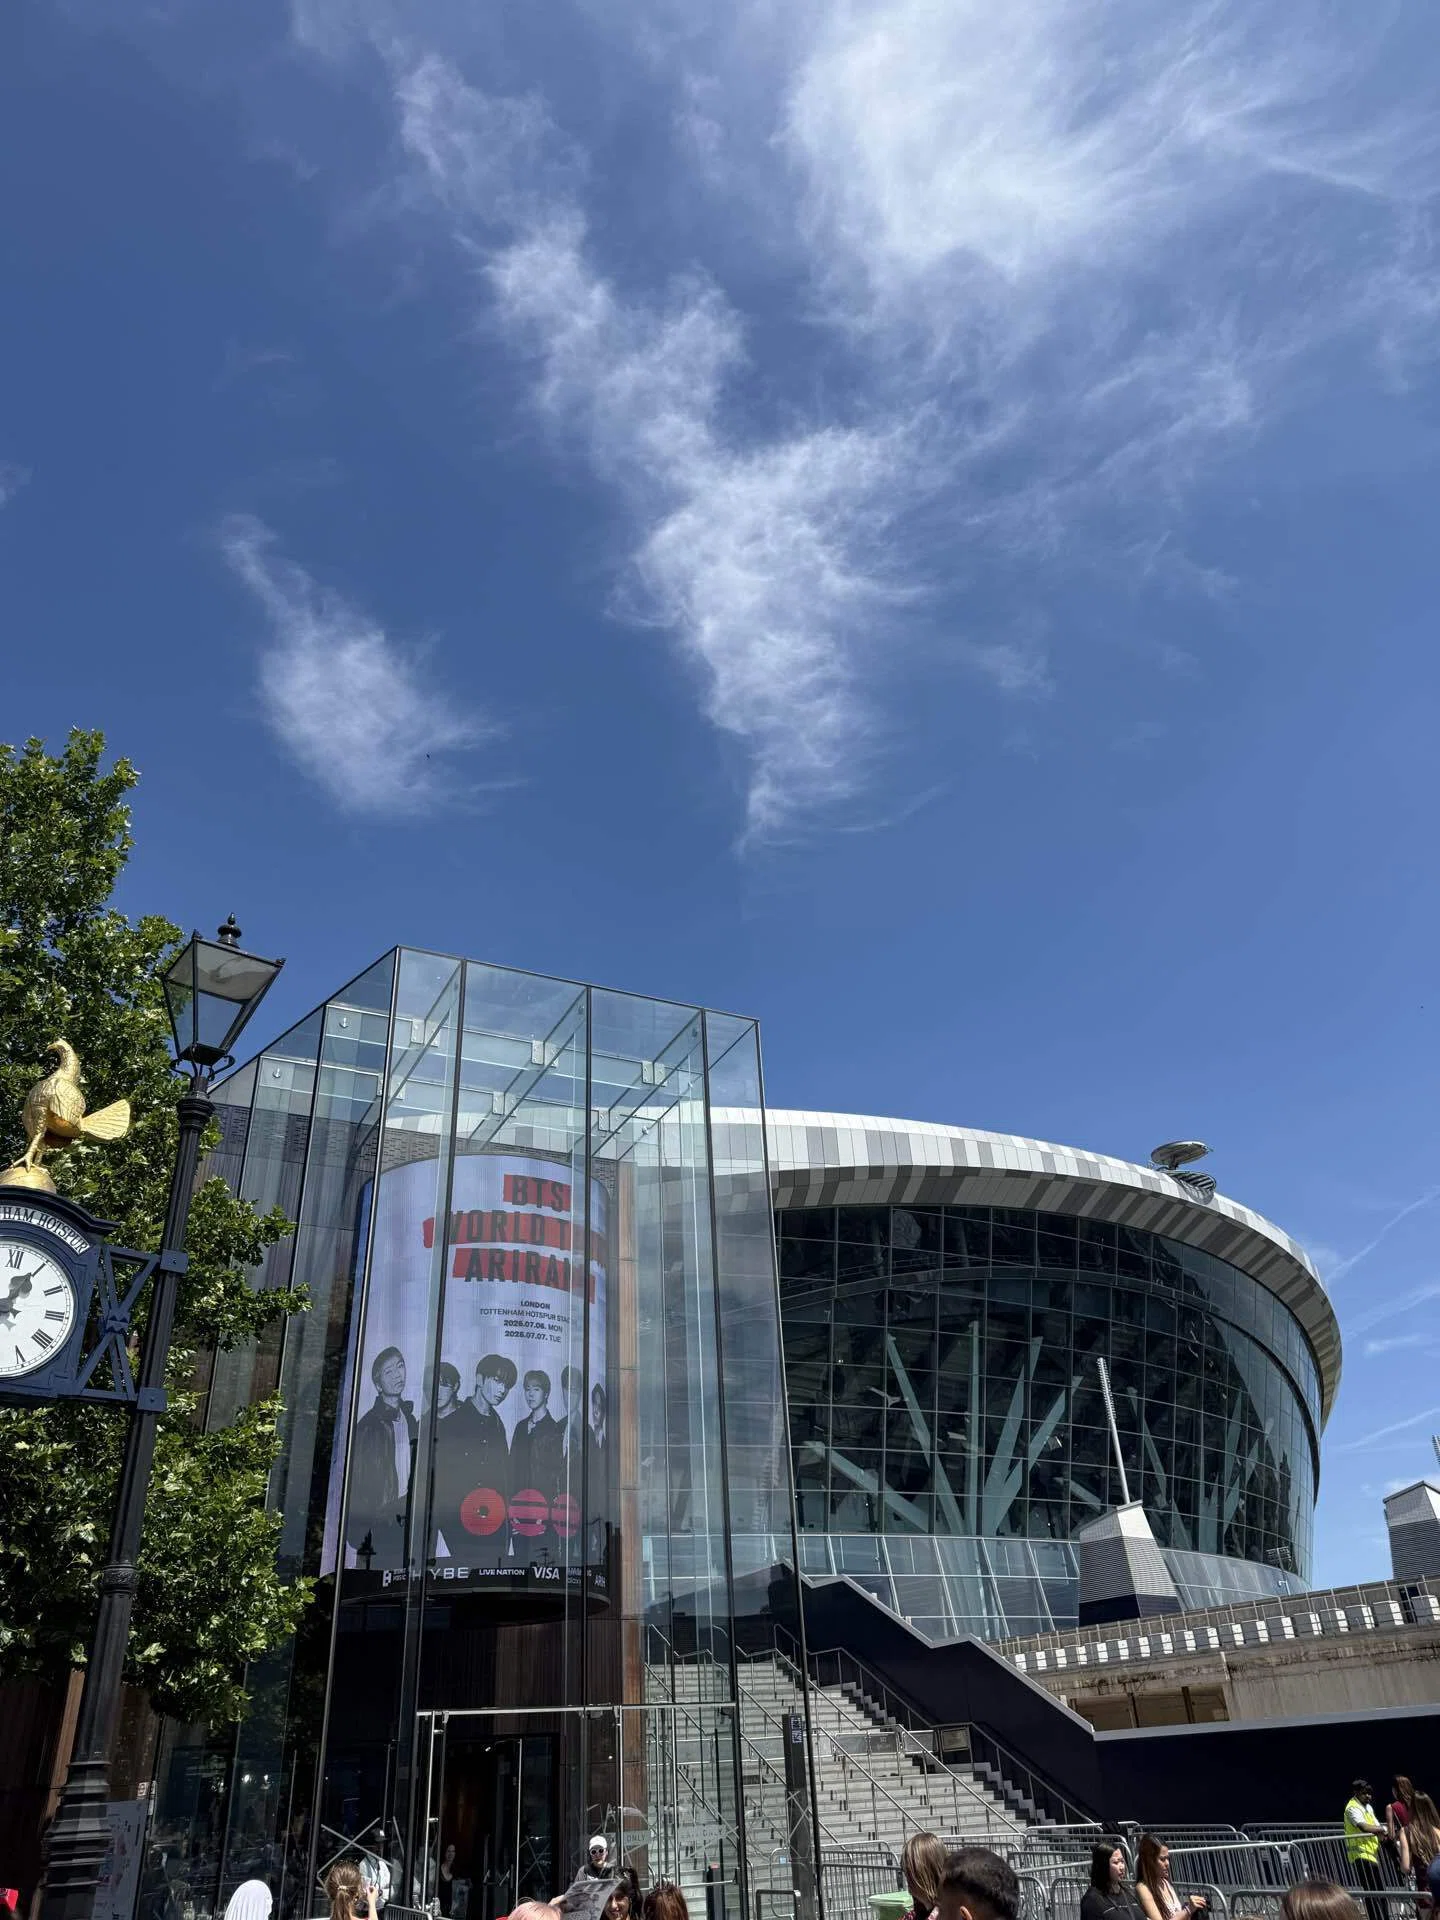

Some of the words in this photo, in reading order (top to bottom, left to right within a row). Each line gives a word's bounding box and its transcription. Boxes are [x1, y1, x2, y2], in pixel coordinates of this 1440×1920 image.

[512, 1175, 564, 1212] BTS
[3, 1206, 36, 1222] HAM
[37, 1213, 88, 1252] HOTSPUR
[520, 1300, 551, 1310] LONDON
[480, 1308, 525, 1317] TOTTENHAM
[526, 1311, 558, 1321] HOTSPUR
[548, 1324, 563, 1333] MON
[549, 1334, 561, 1343] TUE
[479, 1568, 496, 1576] LIVE
[497, 1568, 525, 1576] NATION
[532, 1566, 560, 1580] VISA
